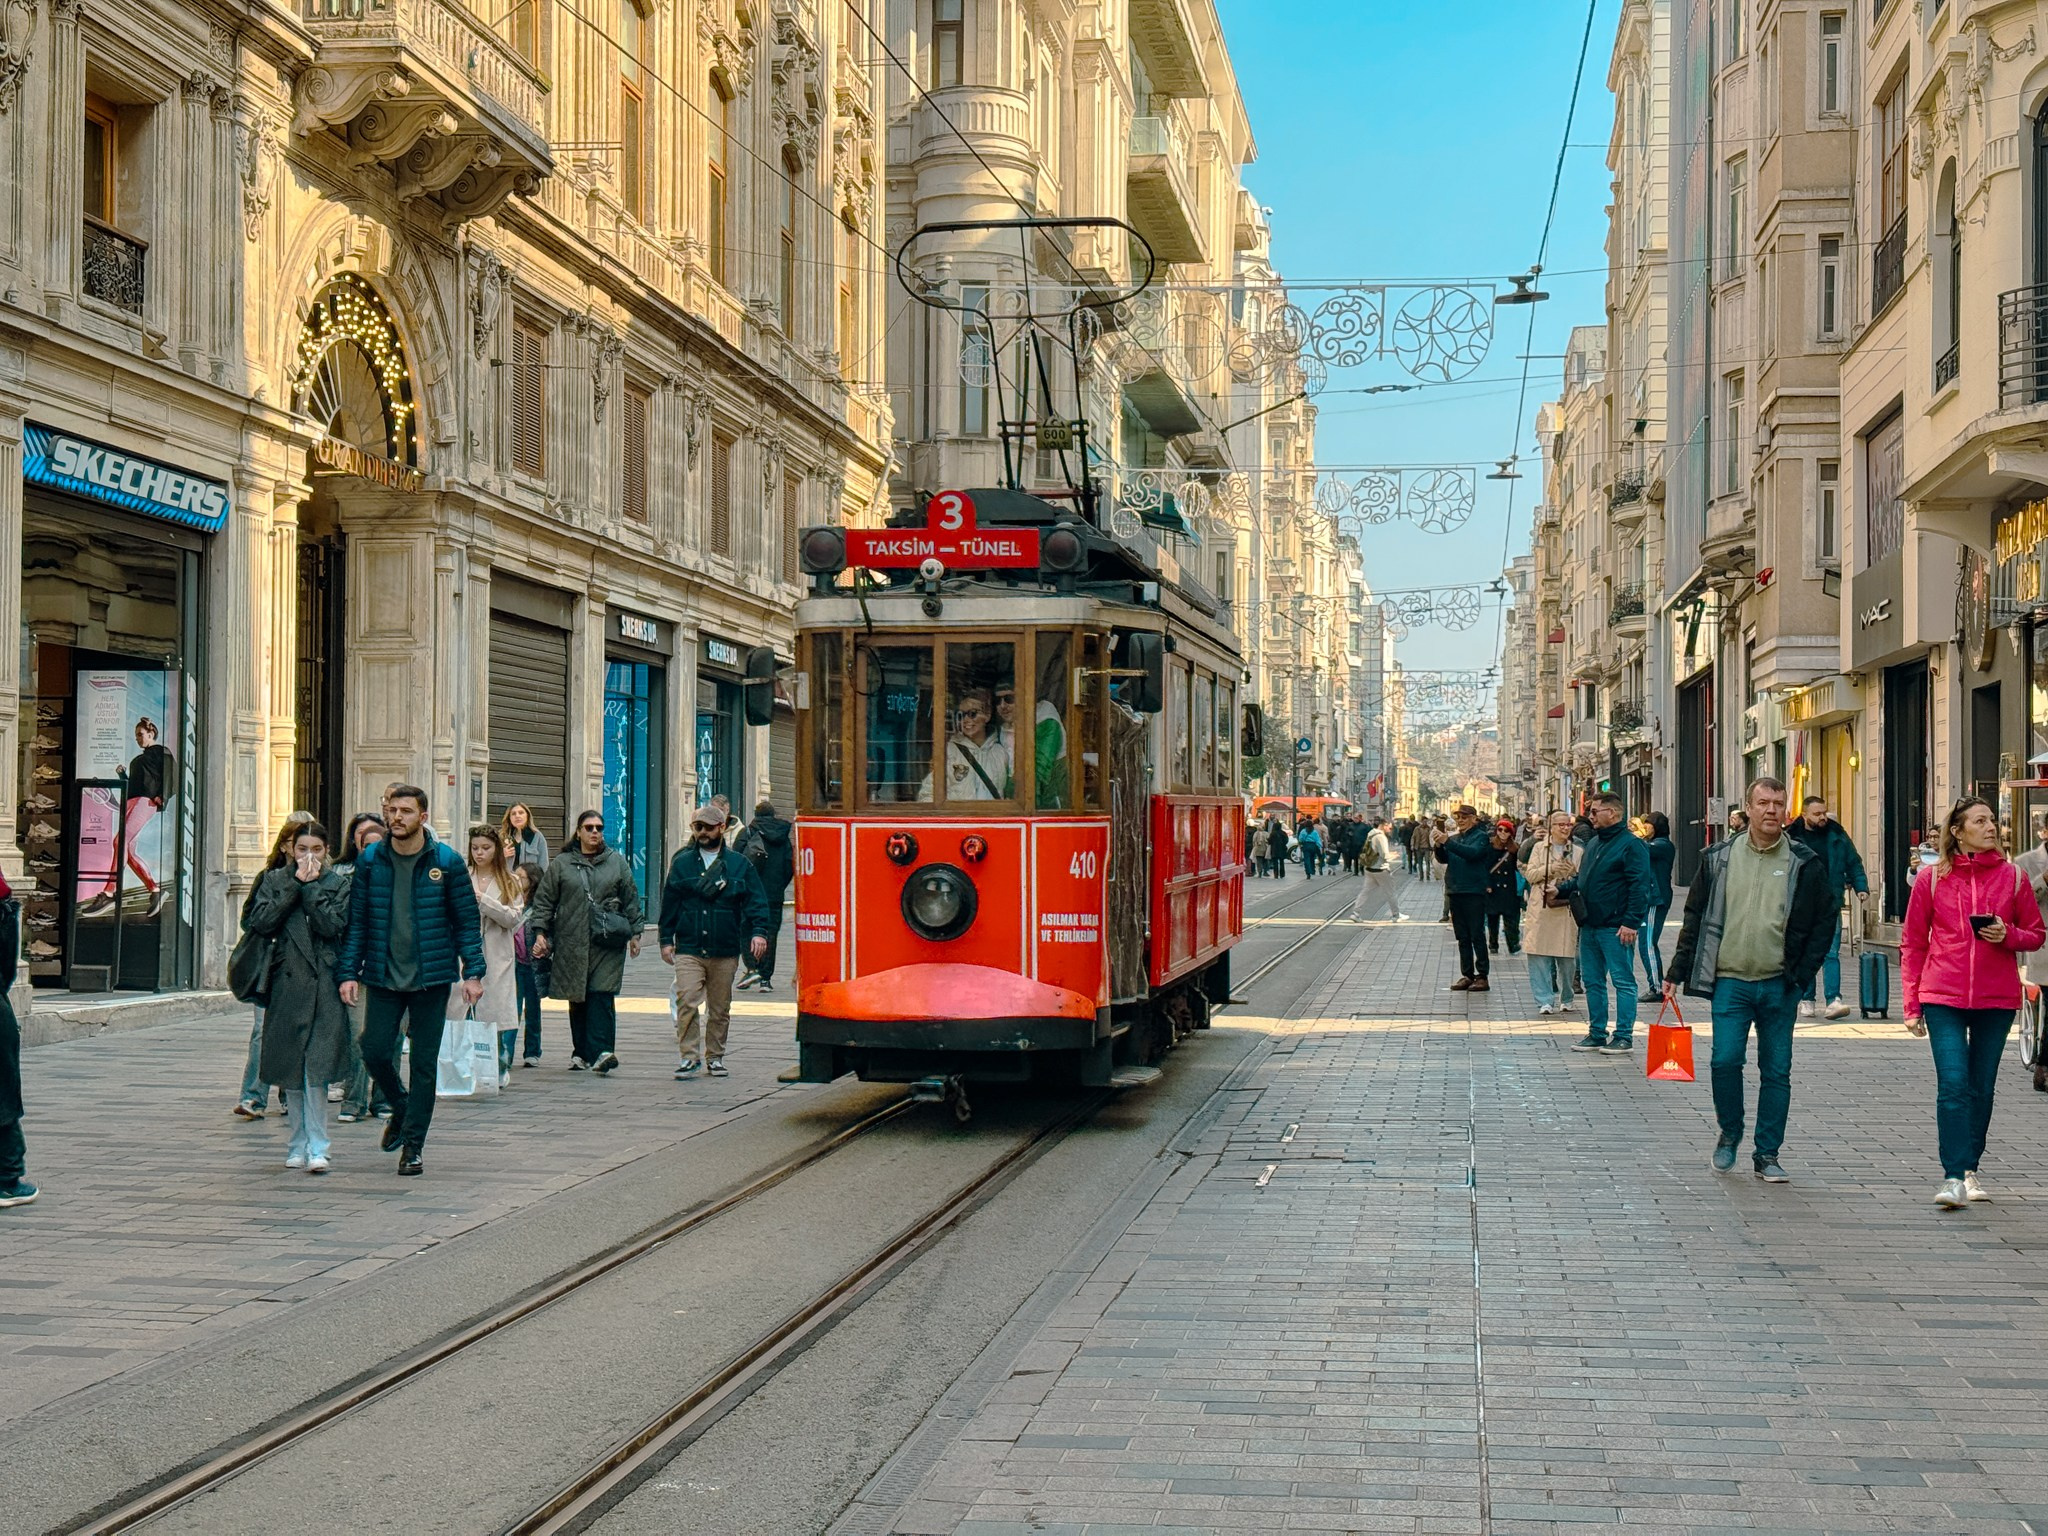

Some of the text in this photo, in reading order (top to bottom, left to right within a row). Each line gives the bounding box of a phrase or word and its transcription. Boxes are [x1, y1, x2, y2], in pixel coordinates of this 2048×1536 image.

[1042, 441, 1069, 449] VOLT
[1043, 429, 1066, 440] 600
[318, 437, 376, 479] GRAND
[51, 440, 227, 519] SKECHERS
[939, 494, 964, 530] 3
[865, 537, 935, 556] TAKSİM
[960, 537, 1022, 556] TÜNEL
[182, 672, 197, 928] SKECHERS
[795, 848, 815, 876] 10
[1069, 850, 1096, 879] 410
[812, 914, 837, 927] YASAK
[1041, 913, 1079, 926] ASILMAK
[1041, 929, 1051, 942] VE
